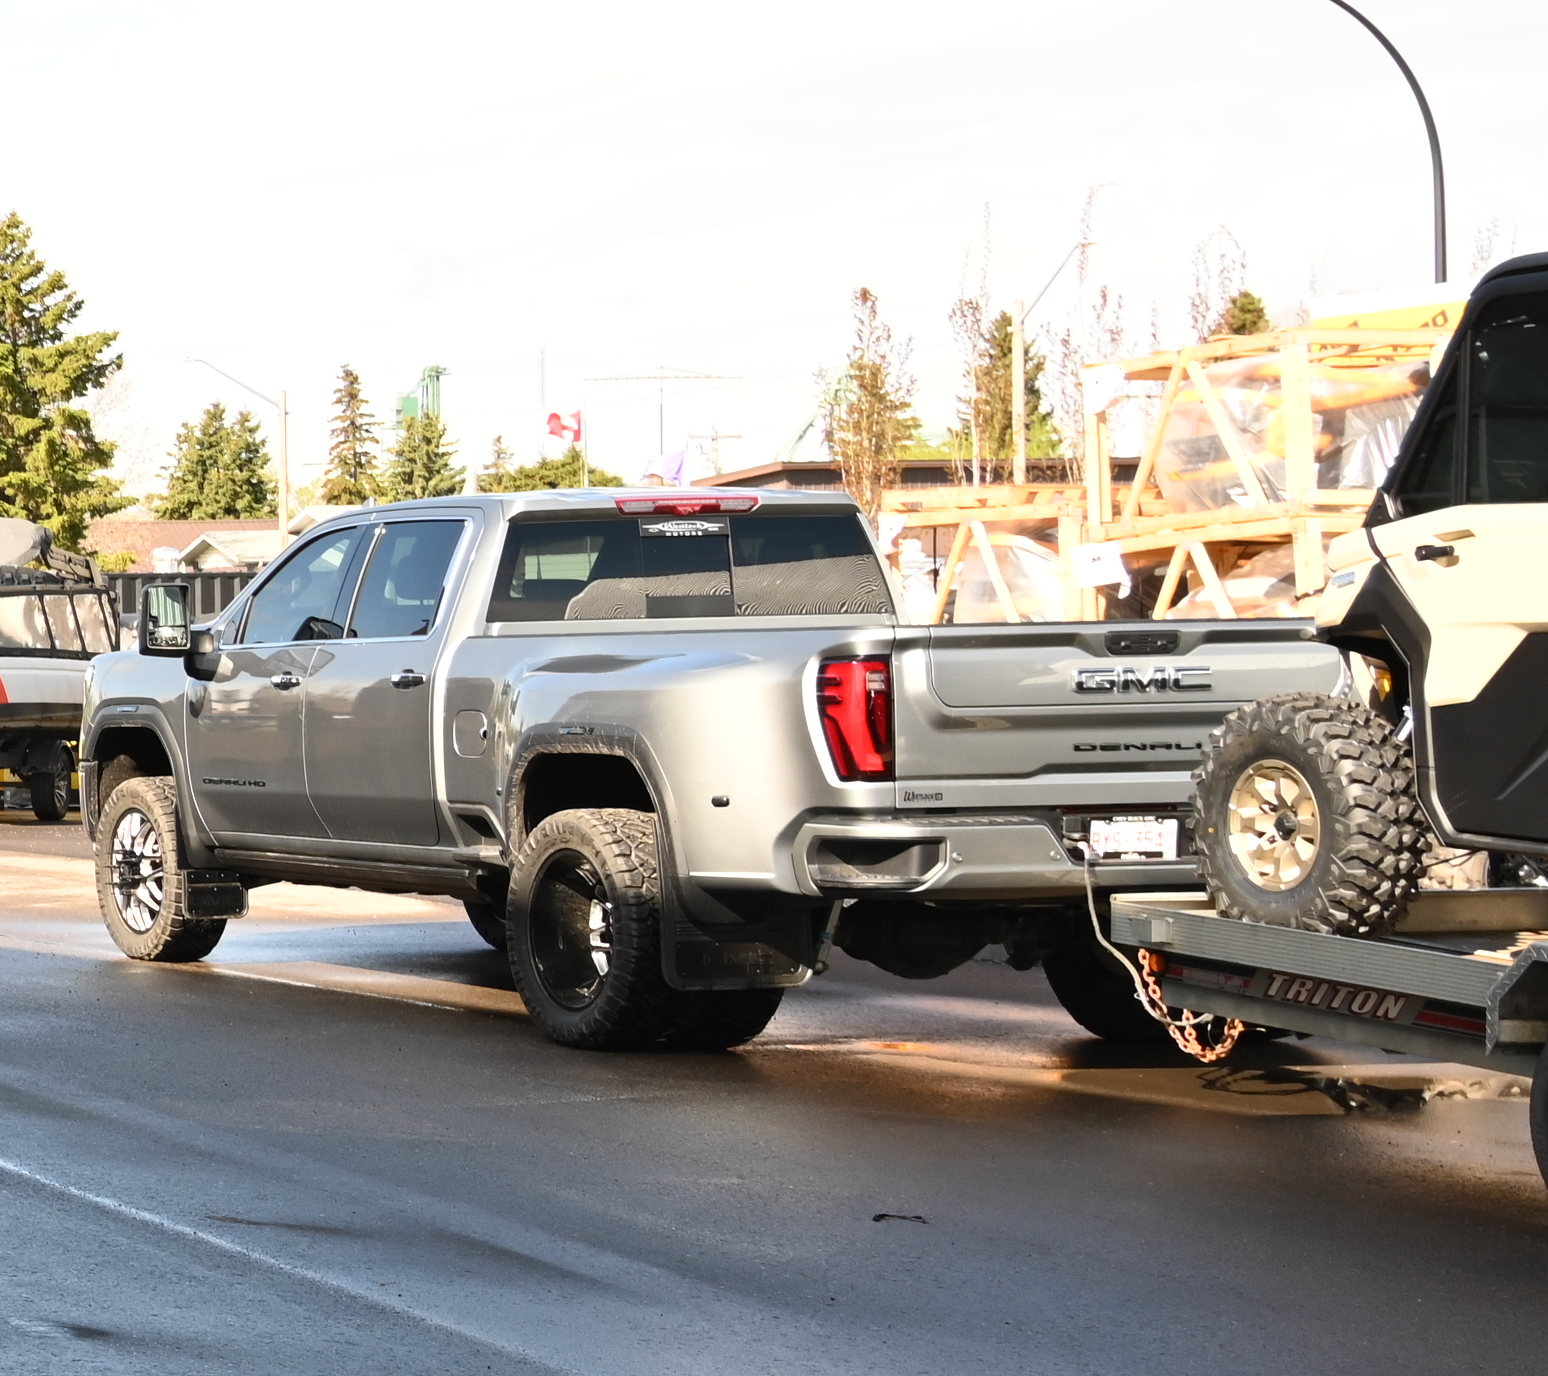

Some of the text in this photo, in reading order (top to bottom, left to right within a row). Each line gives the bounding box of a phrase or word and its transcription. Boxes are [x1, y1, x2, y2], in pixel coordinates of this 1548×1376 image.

[1072, 665, 1213, 694] GMC
[1073, 741, 1203, 752] DENALI
[202, 777, 247, 787] DENALI
[1266, 973, 1407, 1020] TRITON
